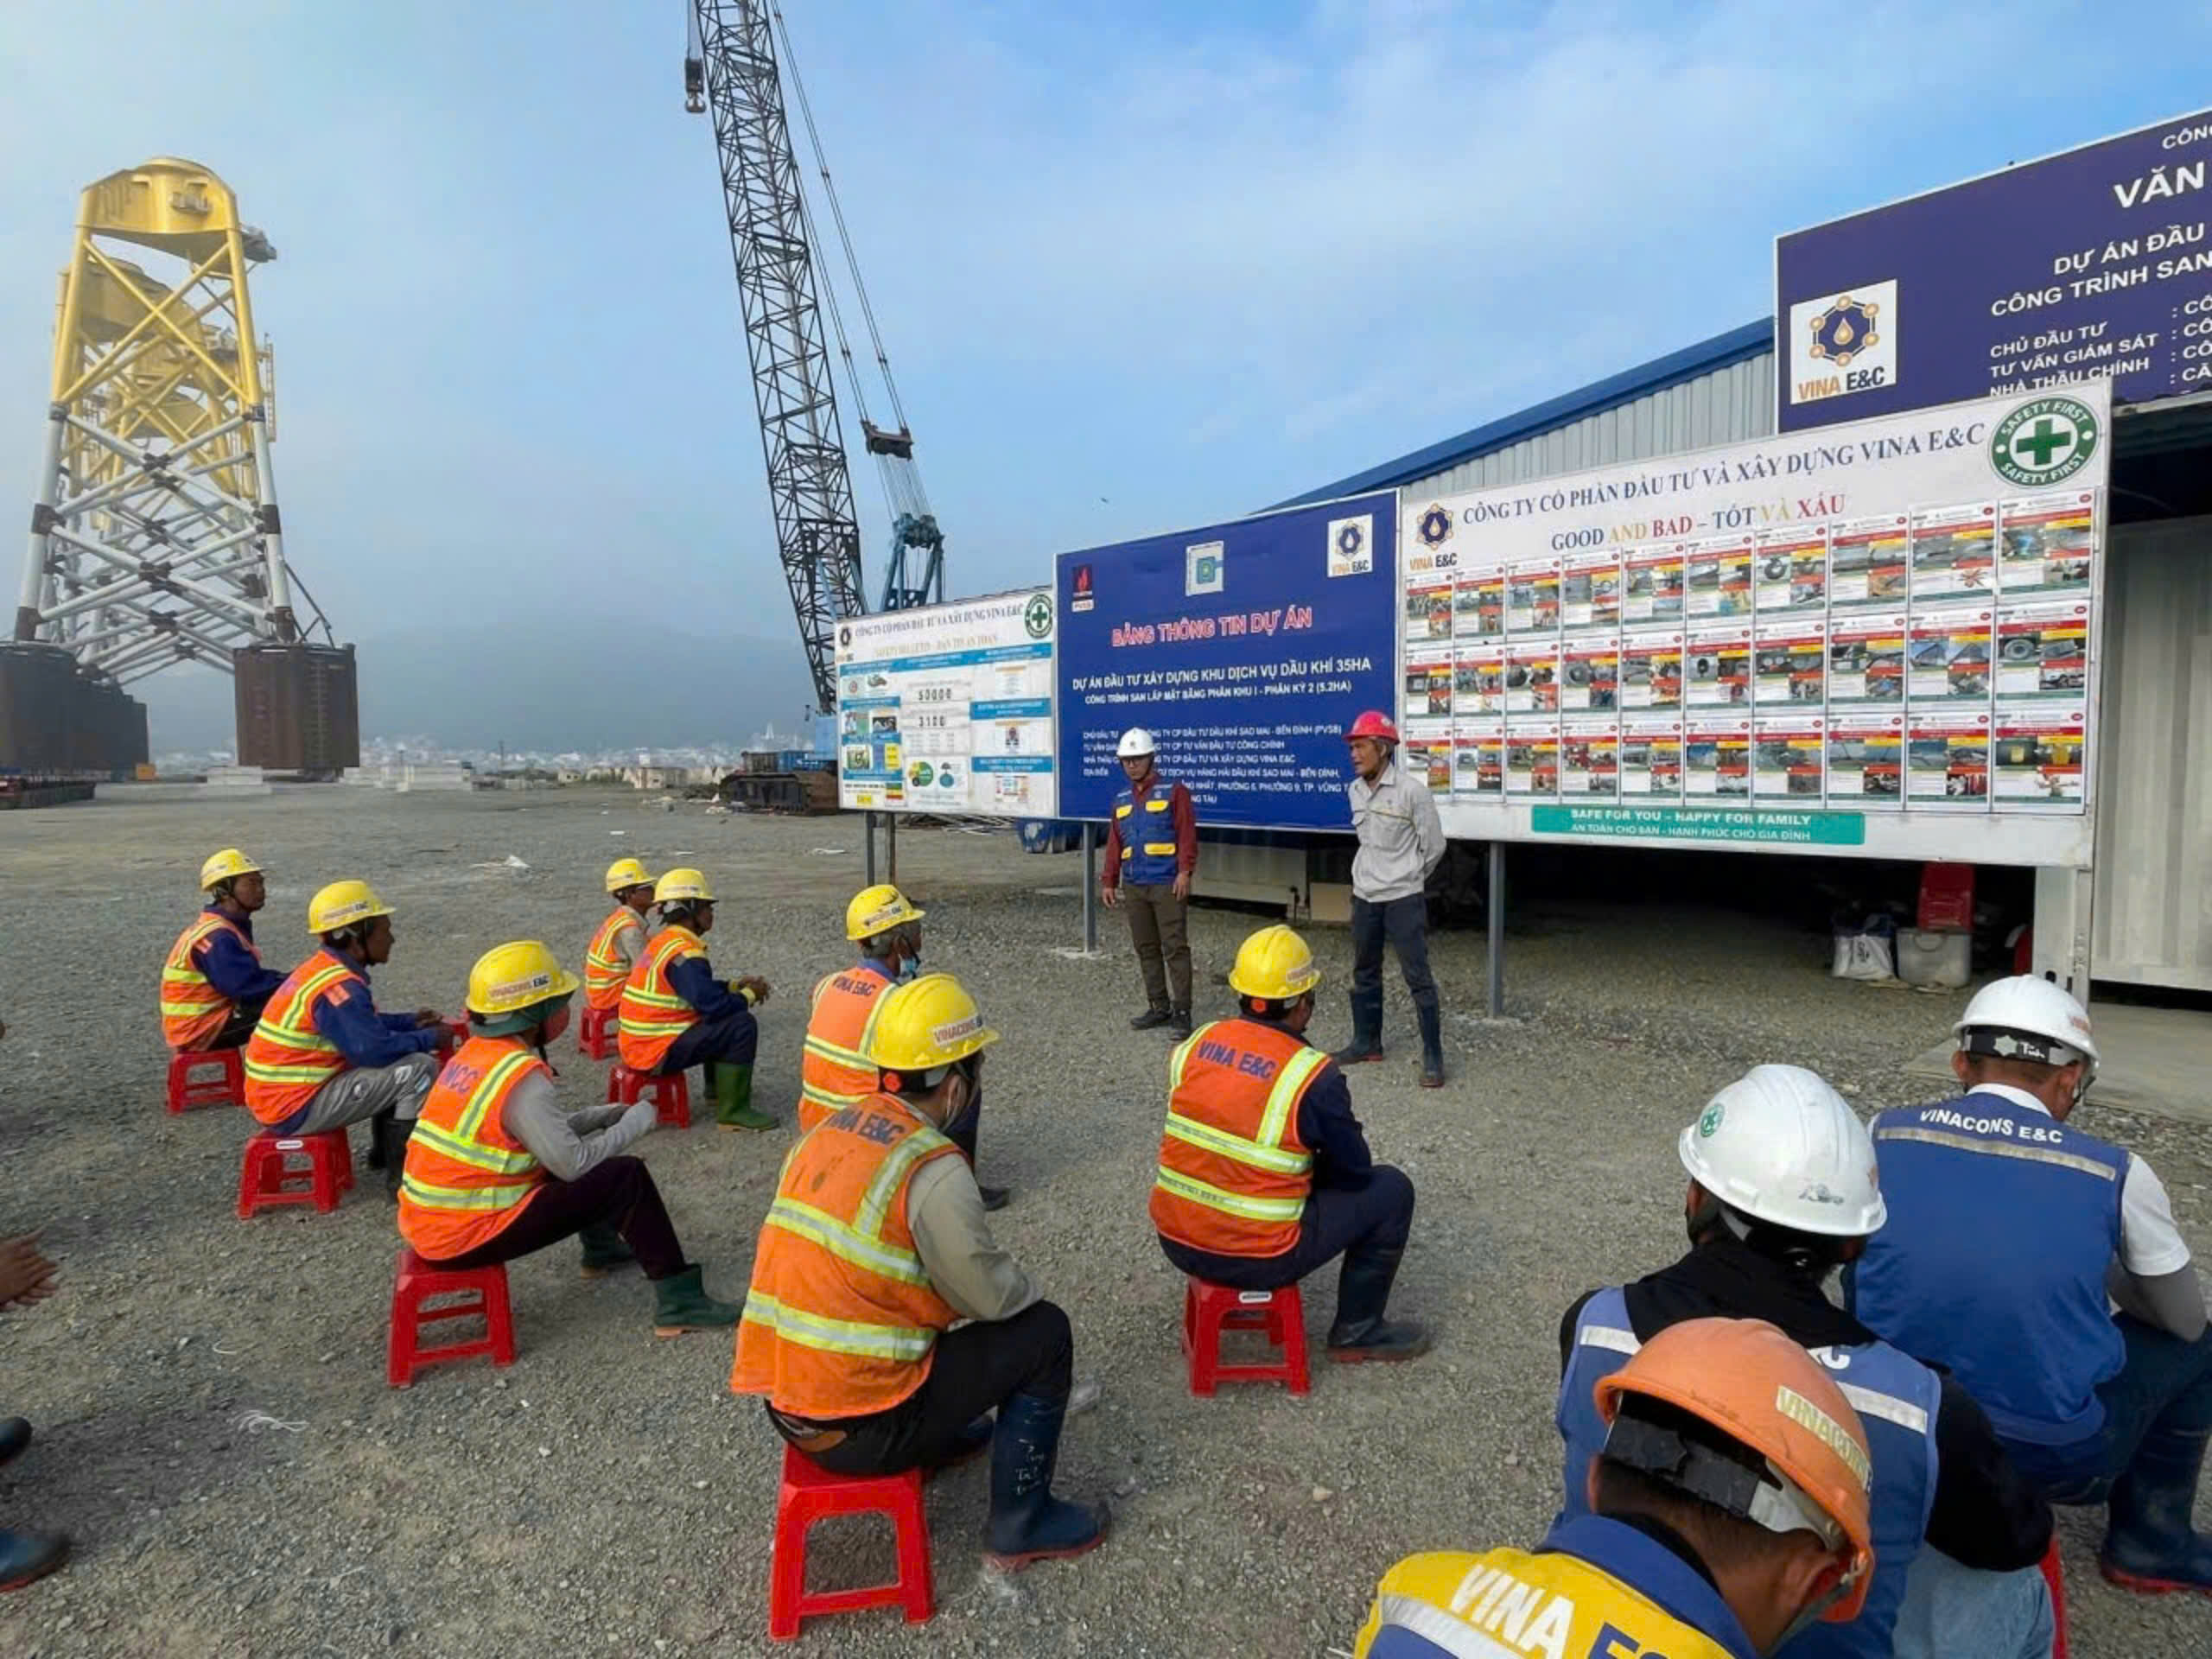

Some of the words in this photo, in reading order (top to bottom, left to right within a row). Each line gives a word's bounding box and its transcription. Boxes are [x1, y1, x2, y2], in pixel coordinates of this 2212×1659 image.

[2162, 124, 2212, 149] CÔN
[2113, 162, 2204, 207] VĂN
[2054, 249, 2094, 274] DỰ
[2101, 239, 2138, 264] ÁN
[2146, 223, 2204, 253] ĐẦU
[1991, 287, 2063, 316] CÔNG
[2069, 266, 2147, 298] TRÌNH
[2156, 251, 2212, 279] SAN
[1990, 336, 2028, 358] CHỦ
[2033, 330, 2072, 350] ĐẦU
[2078, 321, 2107, 340] TƯ
[1990, 360, 2017, 378] TƯ
[2020, 352, 2058, 372] VẤN
[2063, 342, 2113, 365] GIÁM
[2119, 333, 2159, 353] SÁT
[1798, 376, 1841, 399] VINA
[1847, 366, 1885, 391] E&C
[1990, 378, 2027, 397] NHÀ
[2032, 370, 2082, 391] THẦU
[2088, 357, 2149, 380] CHÍNH
[2001, 401, 2050, 435] SAFETY
[2053, 401, 2088, 423] FIRST
[1463, 500, 1510, 524] CÔNG
[1514, 498, 1535, 517] TY
[1669, 467, 1699, 492] TƯ
[1737, 454, 1782, 481] XÂY
[1787, 445, 1854, 476] DỰNG
[1860, 435, 1922, 461] VINA
[1928, 423, 1985, 453] E&C
[2000, 462, 2048, 483] SAFETY
[2050, 453, 2085, 480] FIRST
[1551, 527, 1604, 551] GOOD
[1608, 522, 1649, 543] AND
[1652, 516, 1693, 538] BAD
[1352, 560, 1369, 572] E&C
[1410, 553, 1433, 571] VINA
[1435, 553, 1458, 568] E&C
[1112, 621, 1155, 647] BẢNG
[1157, 616, 1216, 642] THÔNG
[1218, 614, 1246, 636] TIN
[1250, 609, 1281, 636] DỰ
[1283, 604, 1313, 630] ÁN
[1072, 677, 1087, 691] DỰ
[1089, 674, 1103, 690] ÁN
[1126, 673, 1141, 686] TƯ
[1143, 670, 1164, 685] XÂY
[1166, 670, 1198, 686] DỰNG
[1201, 667, 1224, 681] KHU
[1228, 665, 1257, 682] DỊCH
[1260, 663, 1277, 680] VỤ
[1281, 659, 1307, 677] DẦU
[1311, 657, 1333, 674] KHÍ
[1337, 658, 1372, 673] 35HA
[1233, 686, 1252, 697] KHU
[1307, 683, 1314, 694] 2
[1316, 680, 1351, 695] (5.2HA)
[1571, 809, 1603, 820] SAFE
[1605, 809, 1630, 820] FOR
[1635, 810, 1661, 821] YOU
[1675, 810, 1721, 823] HAPPY
[1726, 812, 1753, 823] FOR
[1758, 813, 1811, 825] FAMILY
[1732, 828, 1756, 838] CHO
[1758, 829, 1778, 839] GIA
[1197, 1039, 1236, 1067] VINA
[1237, 1052, 1276, 1079] E&C
[1920, 1109, 2014, 1136] VINACONS
[2018, 1126, 2063, 1143] E&C
[1450, 1563, 1575, 1659] VINA
